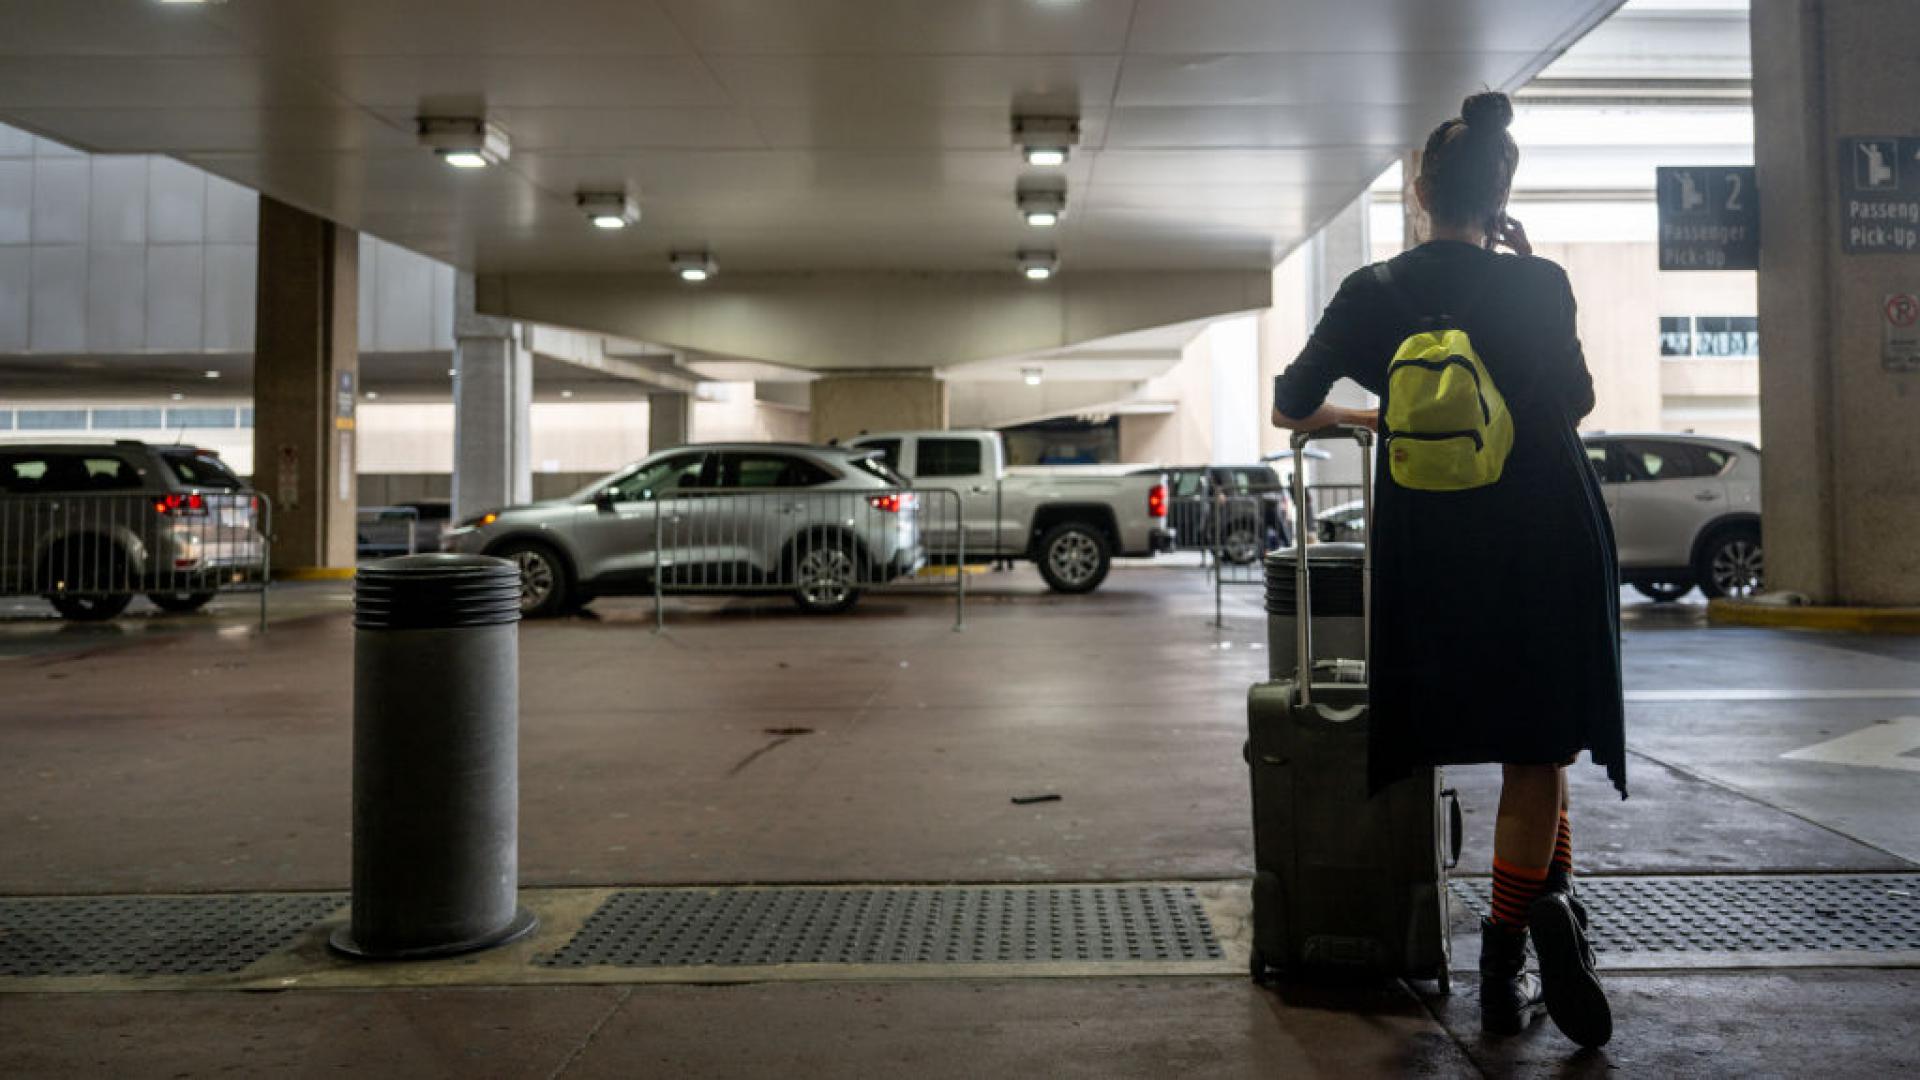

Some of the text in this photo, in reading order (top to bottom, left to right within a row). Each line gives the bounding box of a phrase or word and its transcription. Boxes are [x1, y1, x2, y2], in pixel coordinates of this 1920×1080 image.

[1725, 174, 1741, 210] 2
[1850, 200, 1919, 223] Passeng
[1850, 225, 1917, 249] Pick-Up
